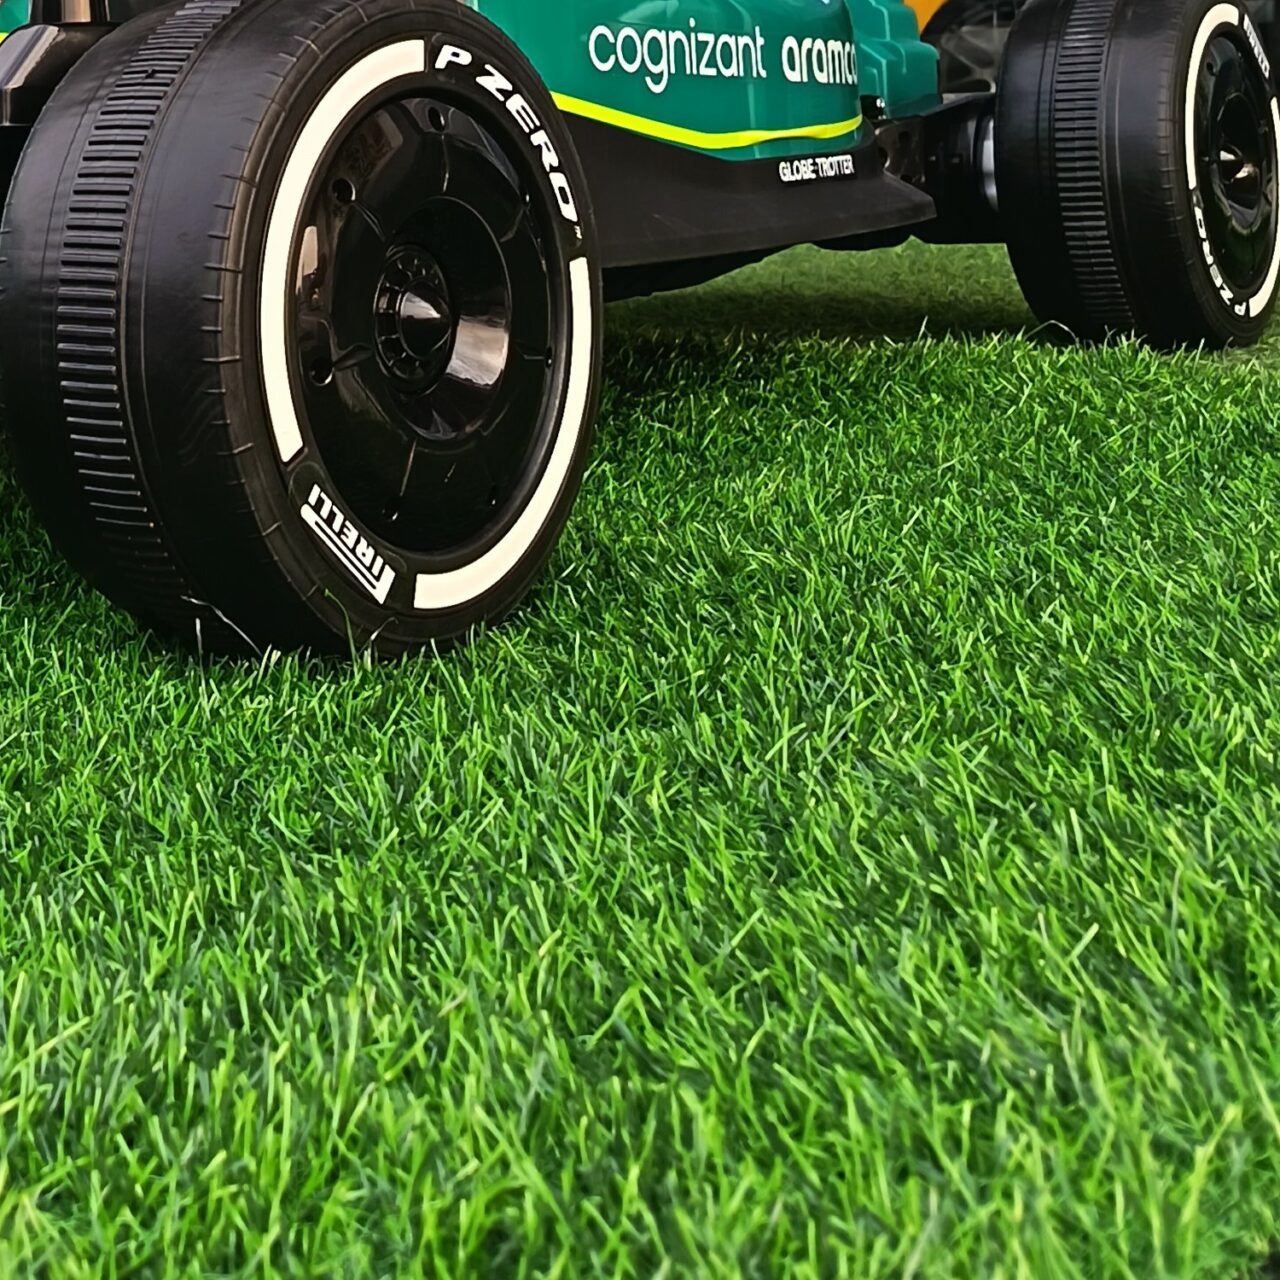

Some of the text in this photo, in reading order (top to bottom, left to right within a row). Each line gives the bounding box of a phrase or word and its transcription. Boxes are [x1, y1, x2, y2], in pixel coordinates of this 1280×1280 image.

[588, 17, 767, 94] cognizant
[434, 44, 579, 223] P ZERO
[300, 483, 397, 605] PIRELLI
